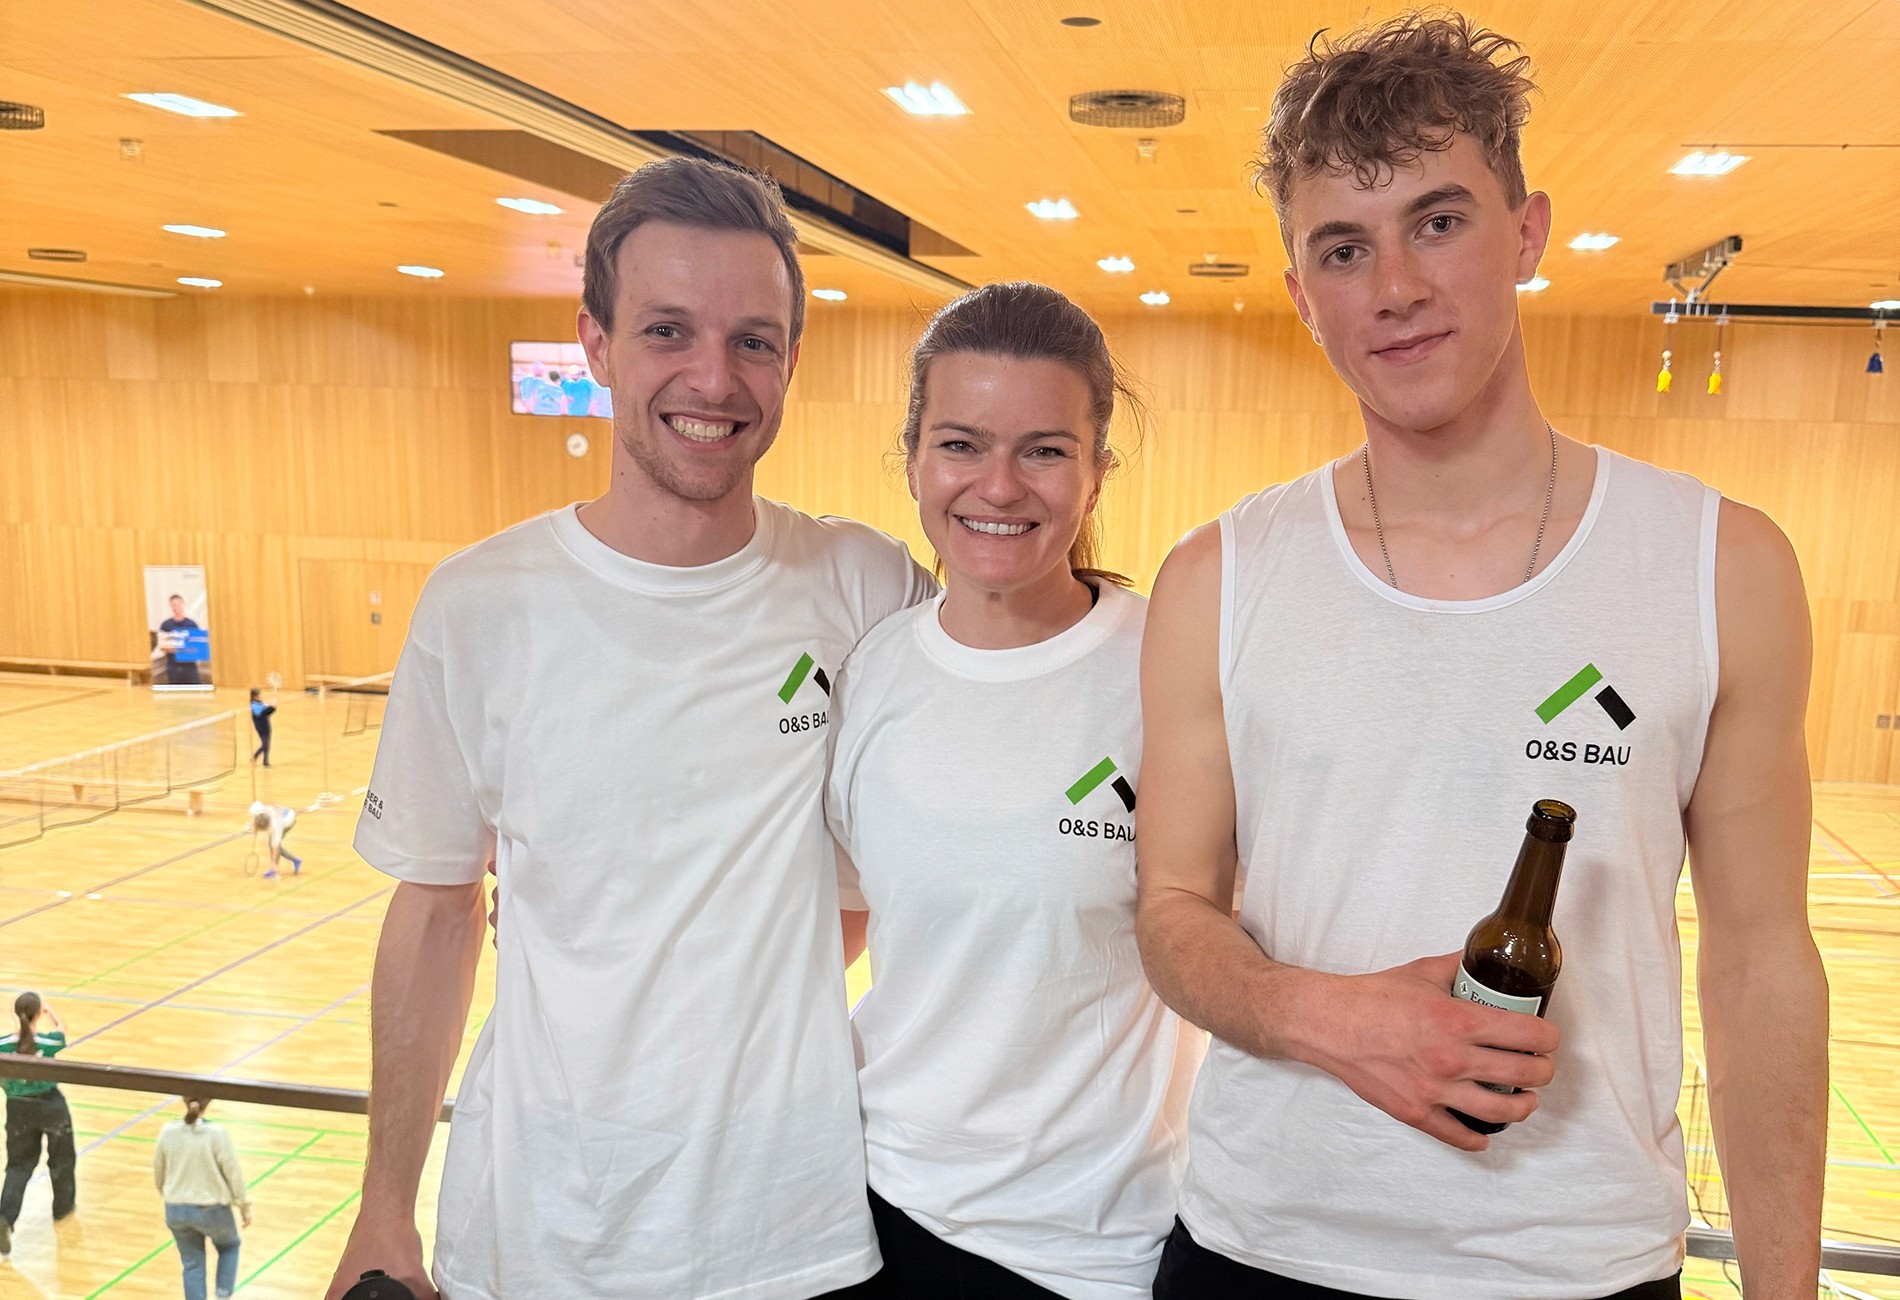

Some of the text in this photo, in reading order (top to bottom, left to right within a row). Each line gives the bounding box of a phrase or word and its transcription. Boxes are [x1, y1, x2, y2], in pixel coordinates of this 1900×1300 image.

[779, 715, 810, 734] O&S
[1526, 740, 1631, 765] O&S BAU
[367, 803, 382, 820] BAU
[1059, 818, 1136, 842] O&S BAU
